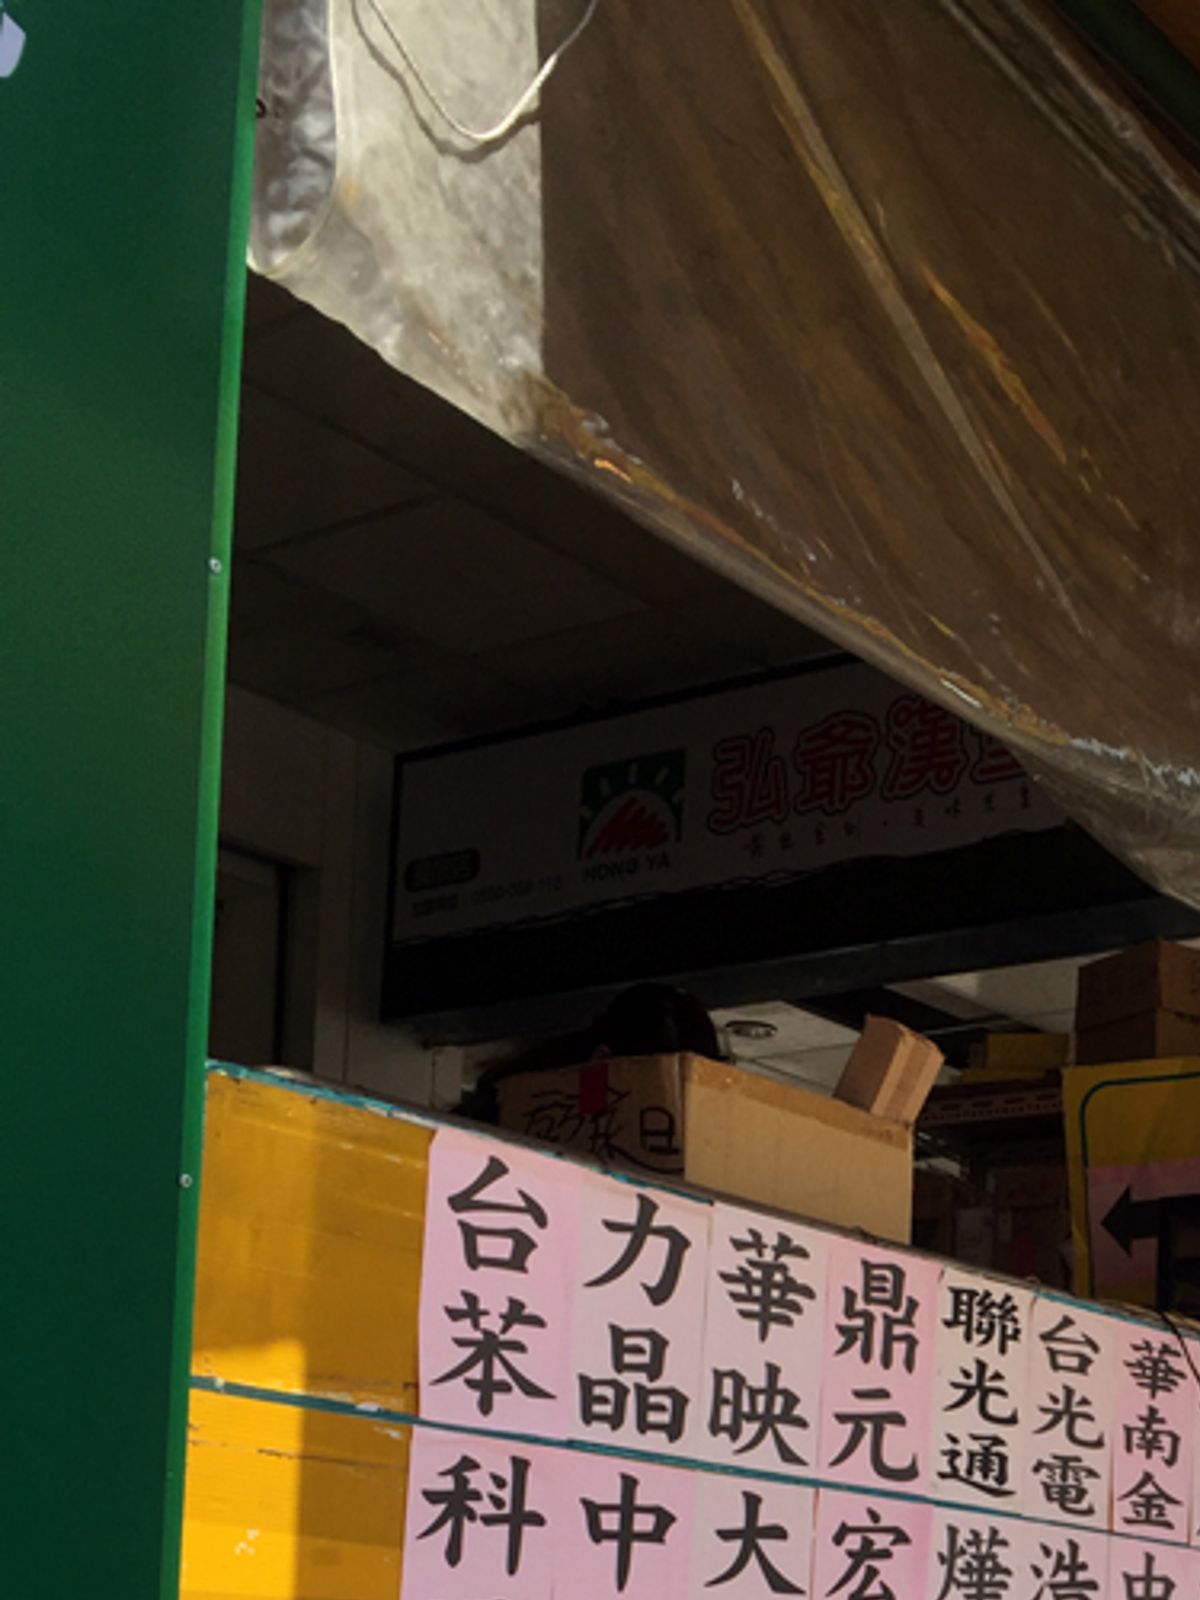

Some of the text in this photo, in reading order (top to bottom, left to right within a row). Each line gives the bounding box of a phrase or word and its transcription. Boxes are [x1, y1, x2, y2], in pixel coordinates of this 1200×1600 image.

[429, 1154, 558, 1416] 台苯
[575, 1192, 692, 1446] 力晶
[707, 1226, 817, 1467] 華映
[828, 1259, 921, 1483] 鼎元
[937, 1287, 1023, 1499] 聯光通
[1032, 1315, 1105, 1518] 台光電
[1116, 1338, 1187, 1531] 華南金
